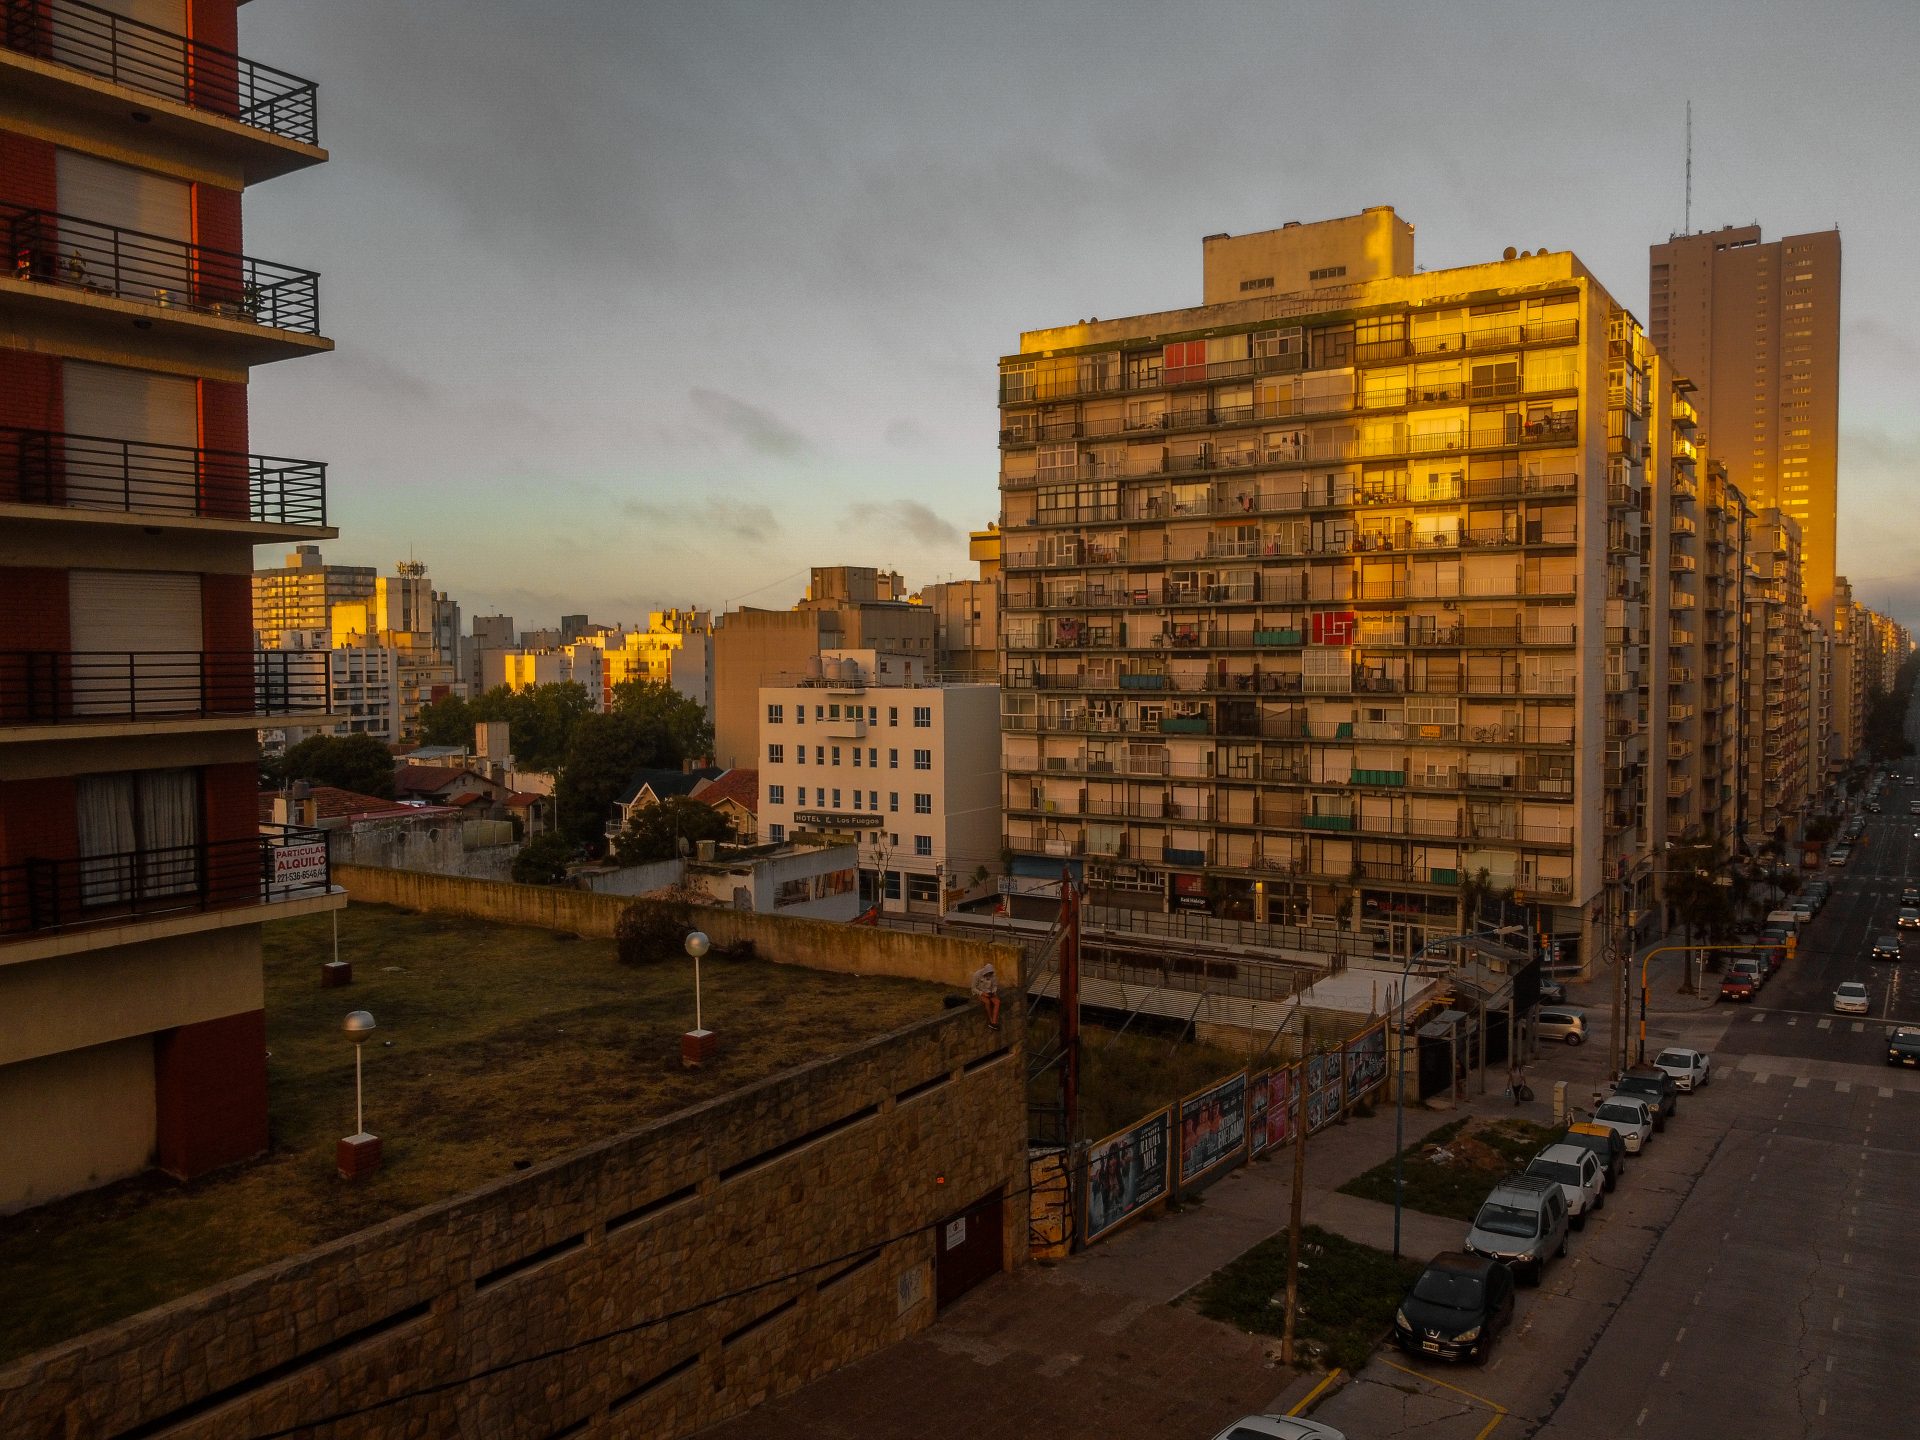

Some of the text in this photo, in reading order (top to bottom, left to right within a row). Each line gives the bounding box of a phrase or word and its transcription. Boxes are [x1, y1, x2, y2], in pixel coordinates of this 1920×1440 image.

[796, 814, 821, 823] HOTEL
[851, 817, 880, 825] Fuegos
[276, 846, 326, 859] PARTICULAR
[277, 855, 326, 871] ALQUILO
